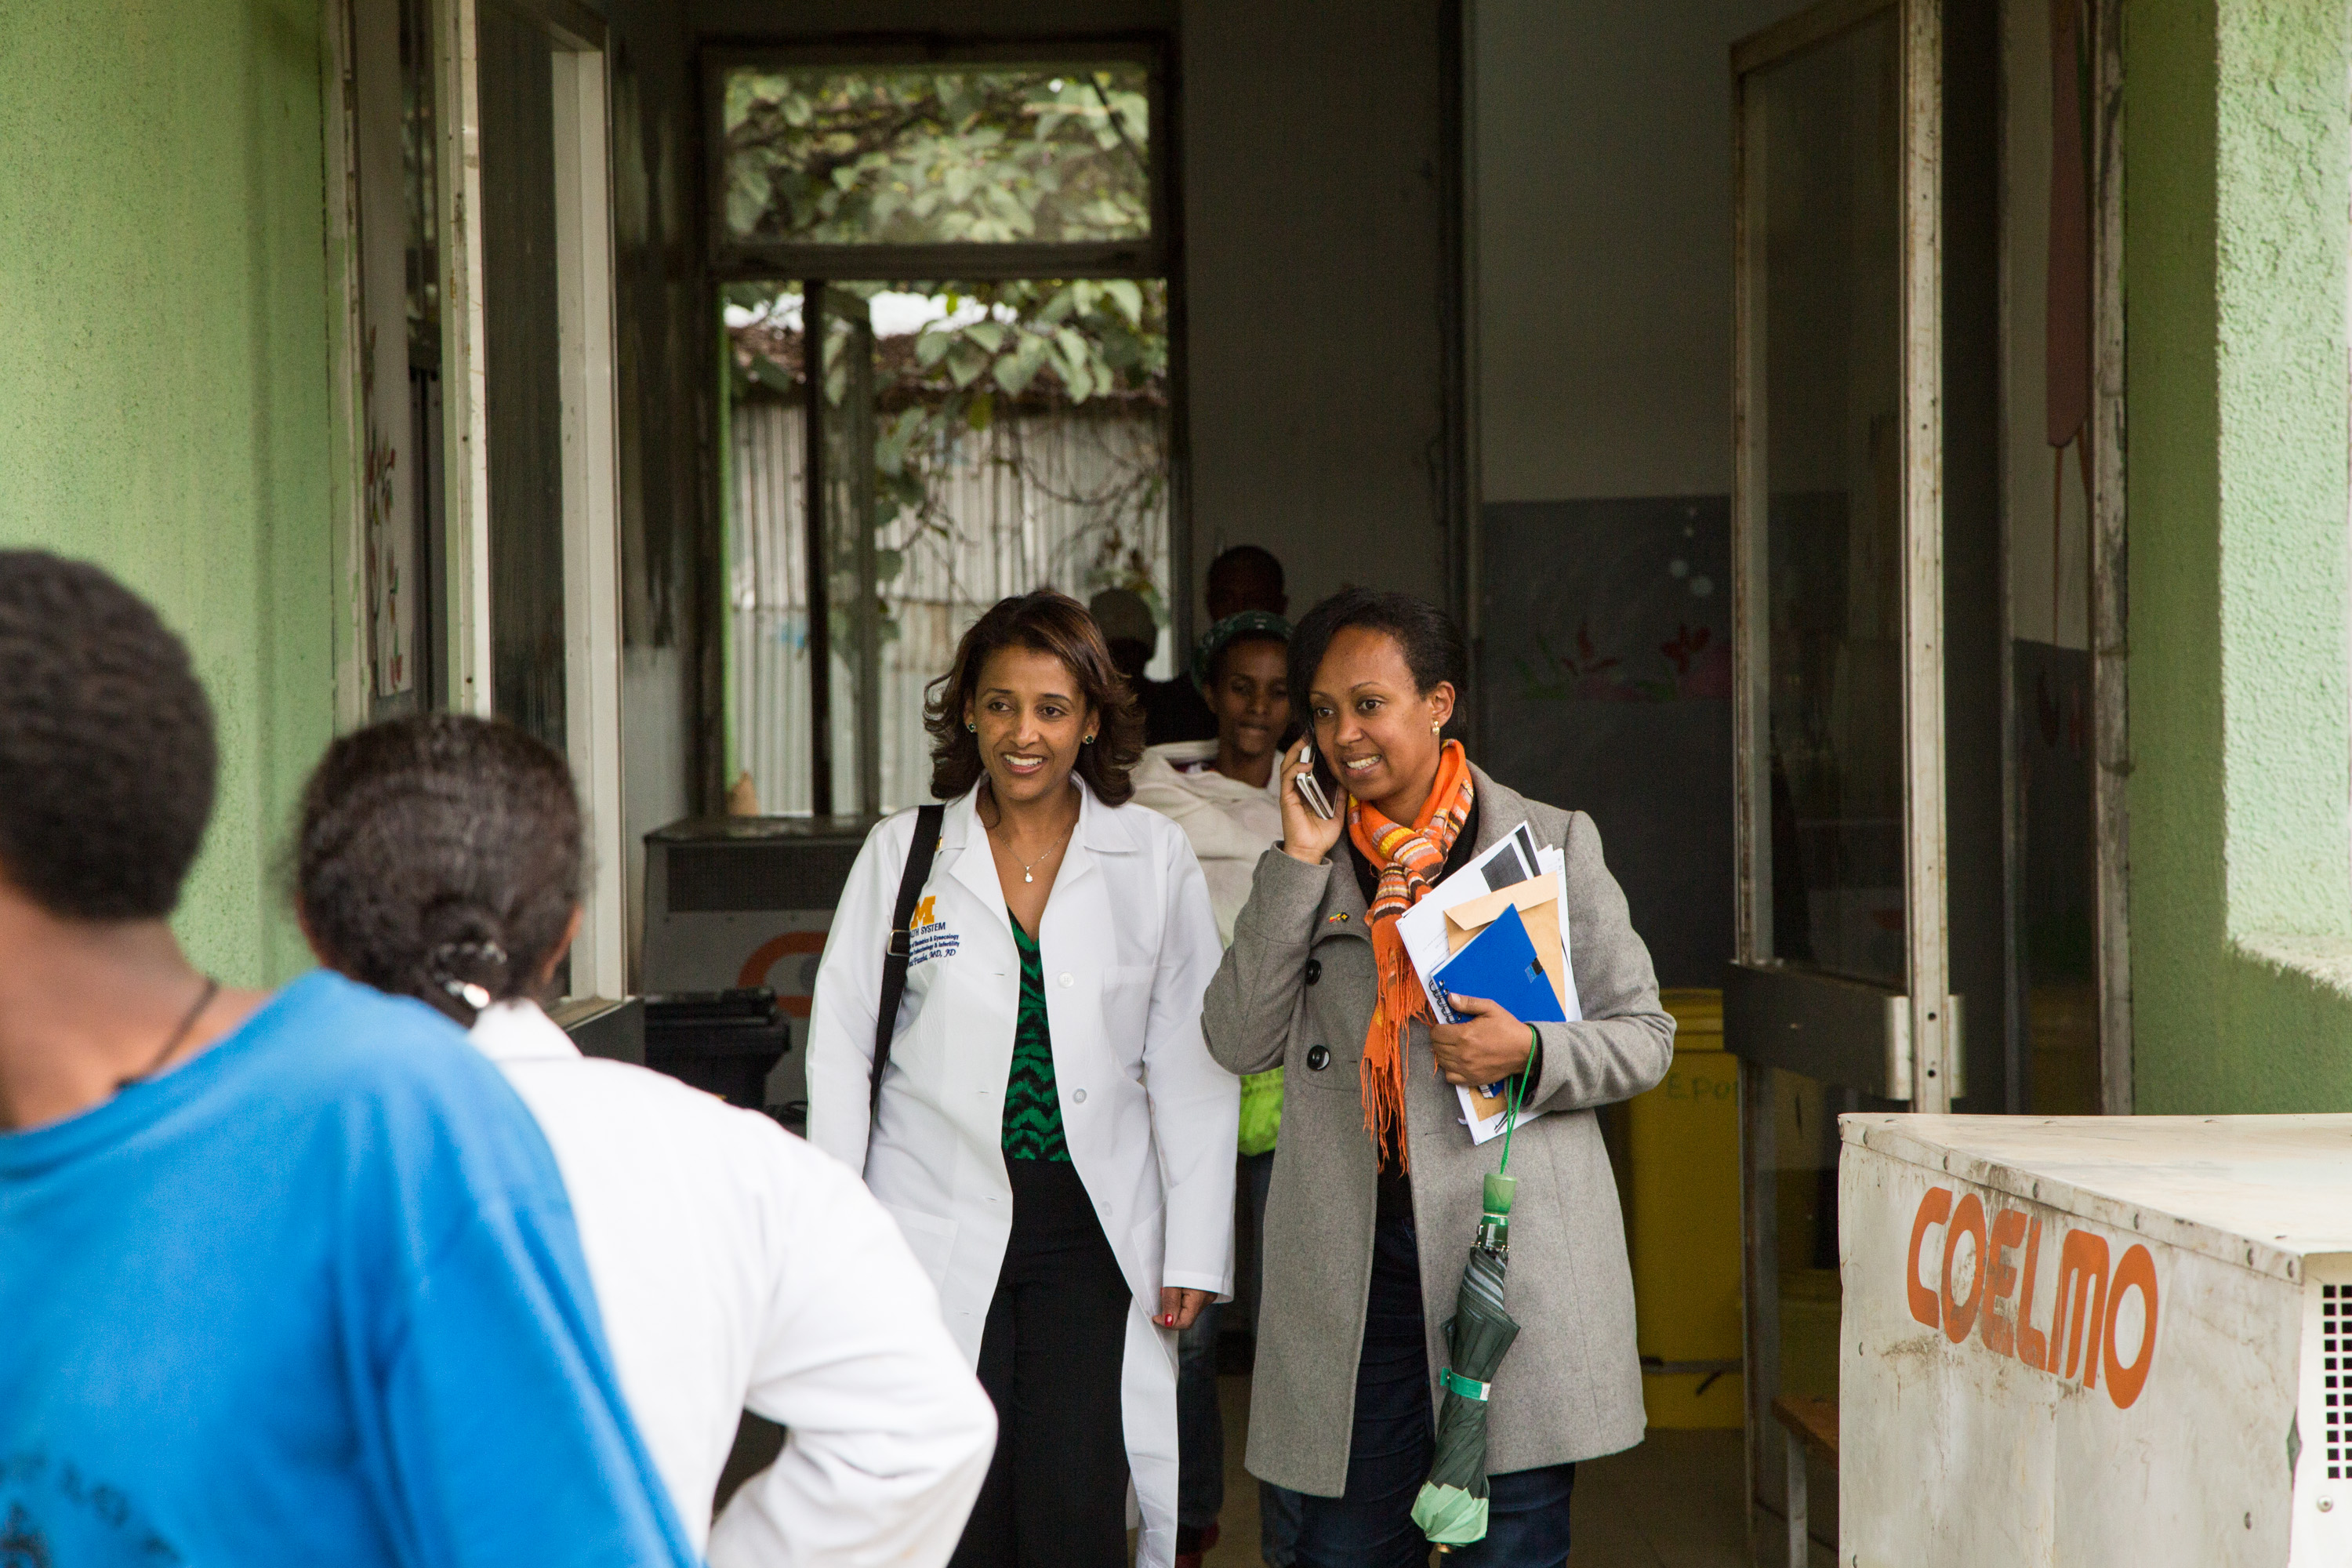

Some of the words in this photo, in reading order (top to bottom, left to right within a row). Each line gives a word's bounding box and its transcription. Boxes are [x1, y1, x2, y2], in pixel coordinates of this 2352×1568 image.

[910, 895, 936, 929] M
[920, 921, 946, 935] SYSTEM
[933, 933, 960, 942] Gynecology
[943, 948, 956, 958] JD
[1906, 1185, 2158, 1410] COELMO
